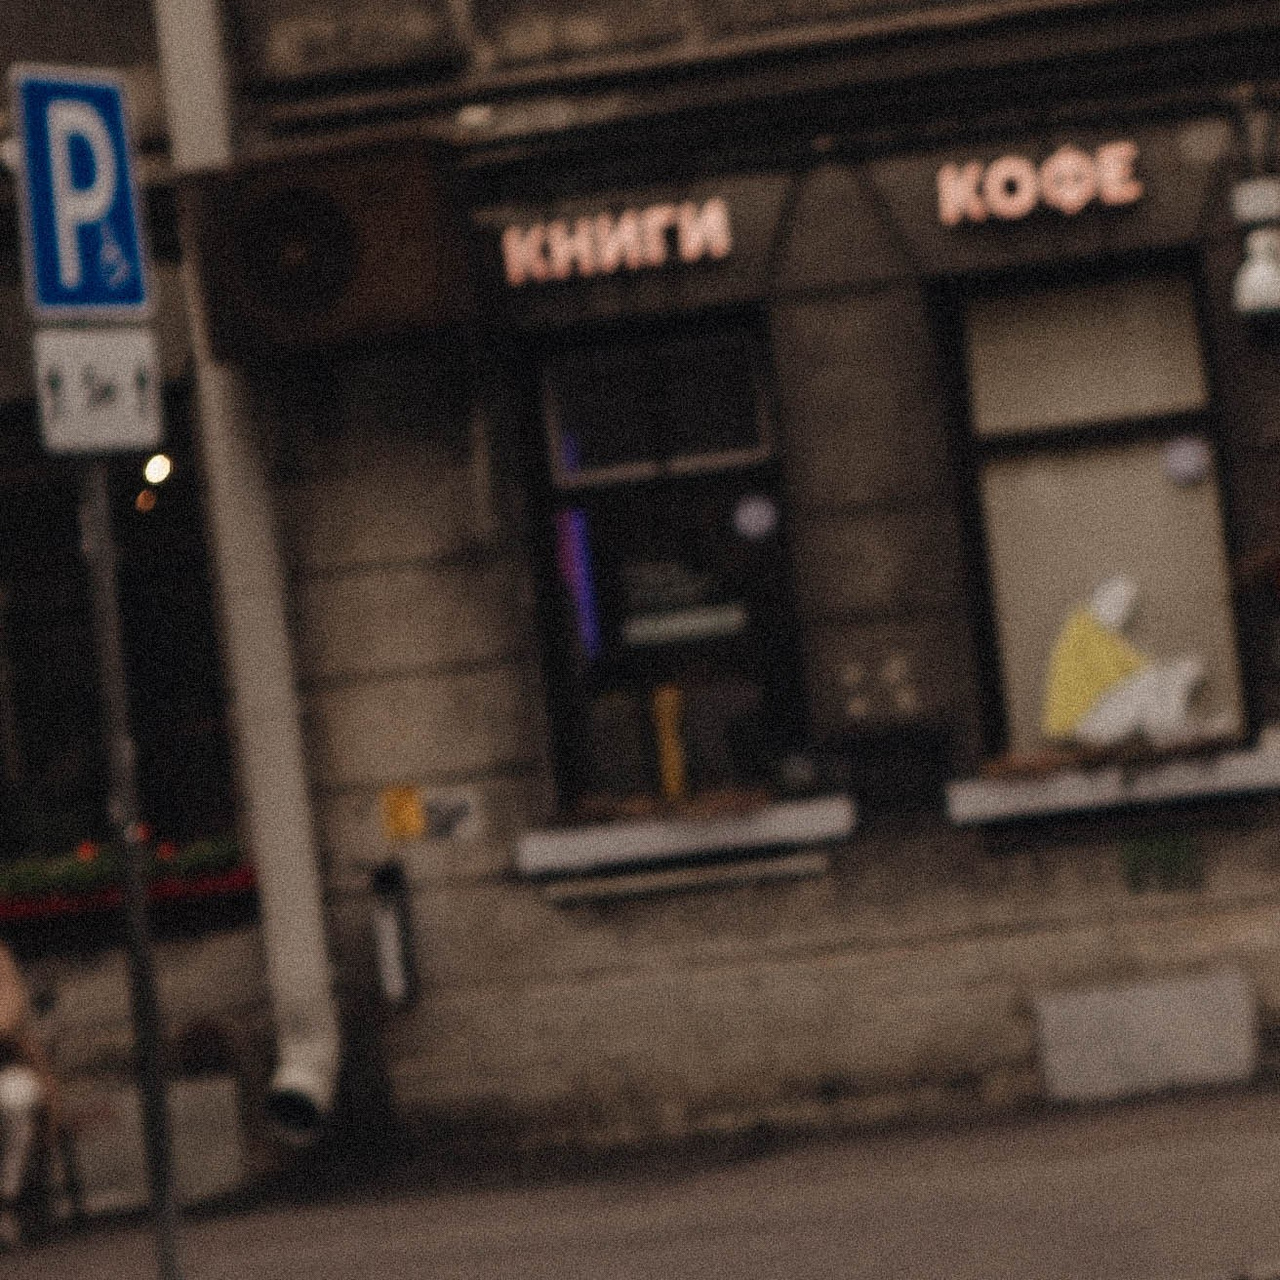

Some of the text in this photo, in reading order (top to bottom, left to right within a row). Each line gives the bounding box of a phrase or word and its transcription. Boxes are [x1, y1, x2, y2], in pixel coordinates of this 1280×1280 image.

[47, 97, 118, 288] P
[938, 140, 1144, 225] КОФЕ
[502, 197, 731, 286] КНИГИ
